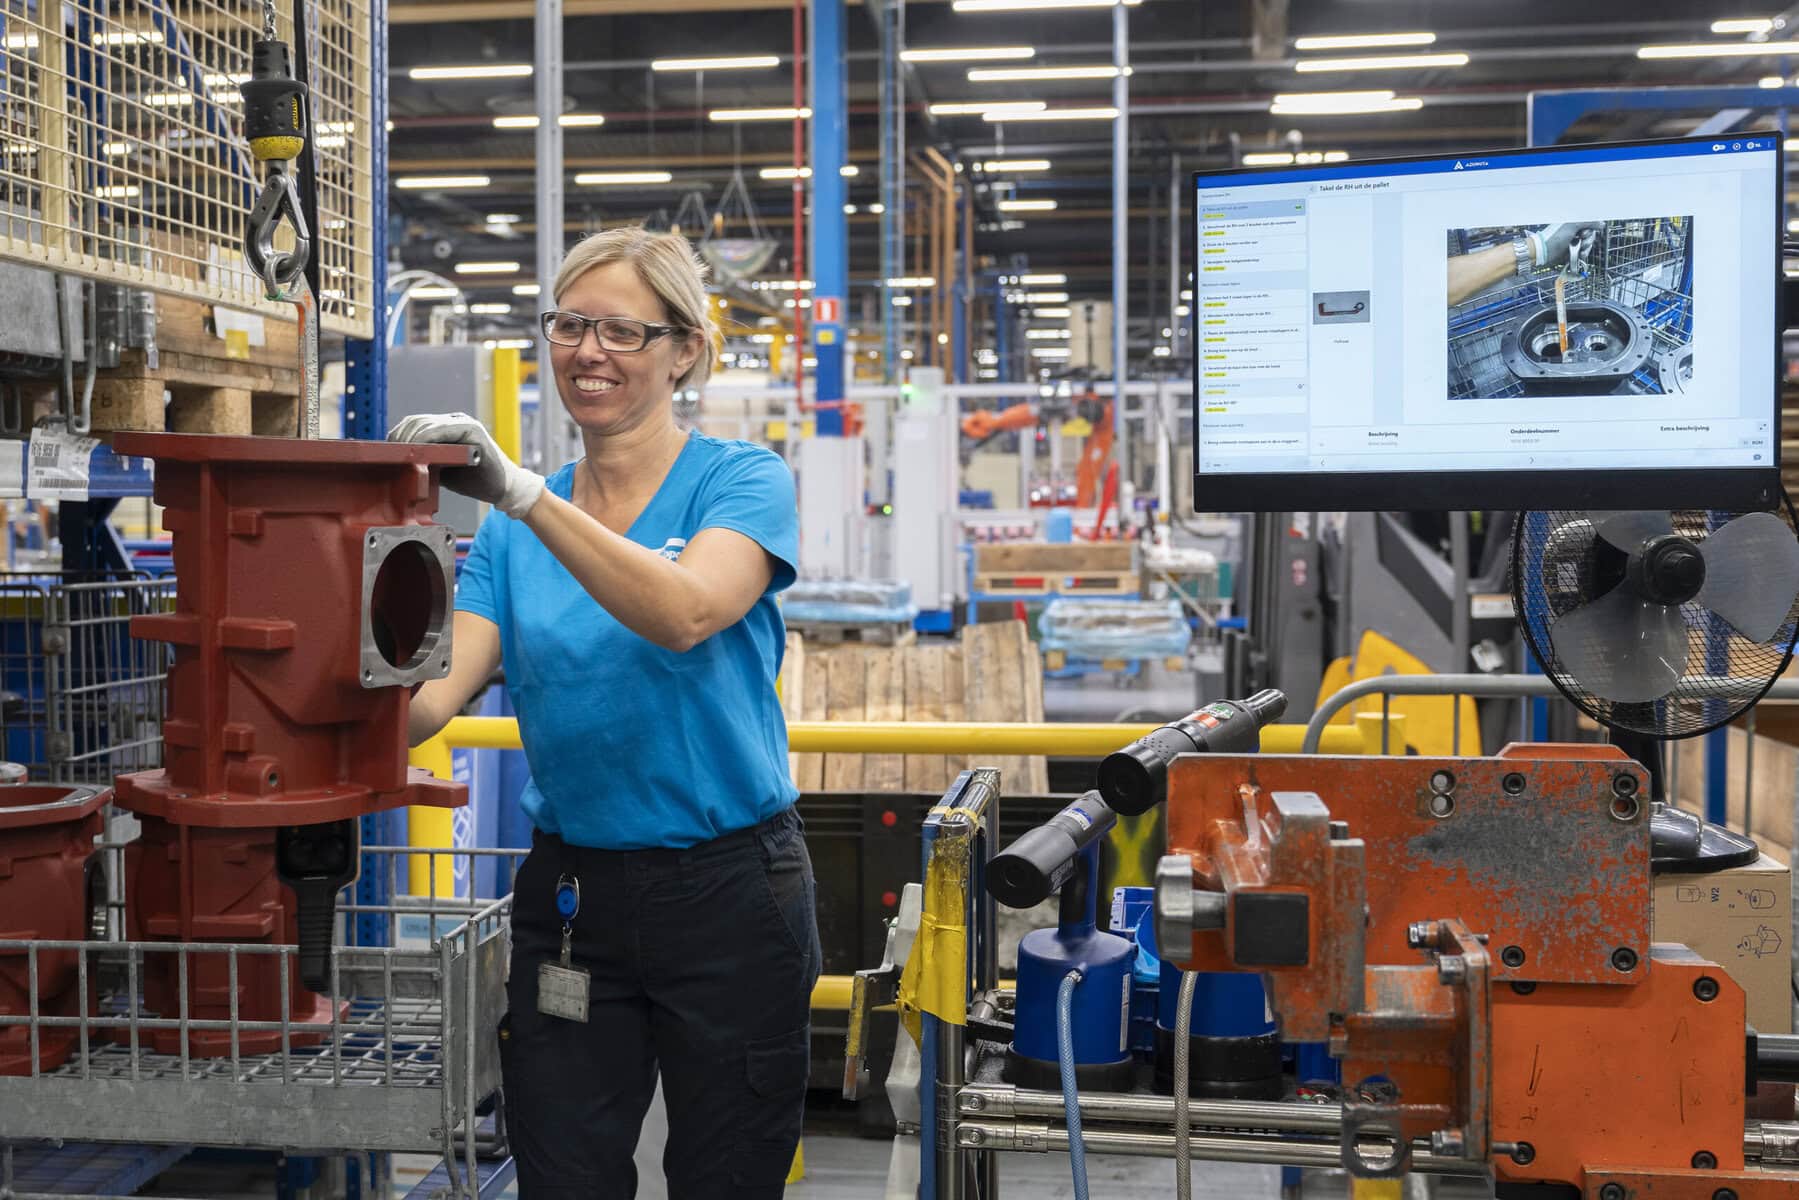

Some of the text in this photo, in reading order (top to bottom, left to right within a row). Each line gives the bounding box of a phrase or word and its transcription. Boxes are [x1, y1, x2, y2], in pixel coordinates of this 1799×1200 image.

[1373, 181, 1390, 190] pallet
[1676, 424, 1710, 432] beschrijving
[1712, 887, 1720, 903] W2
